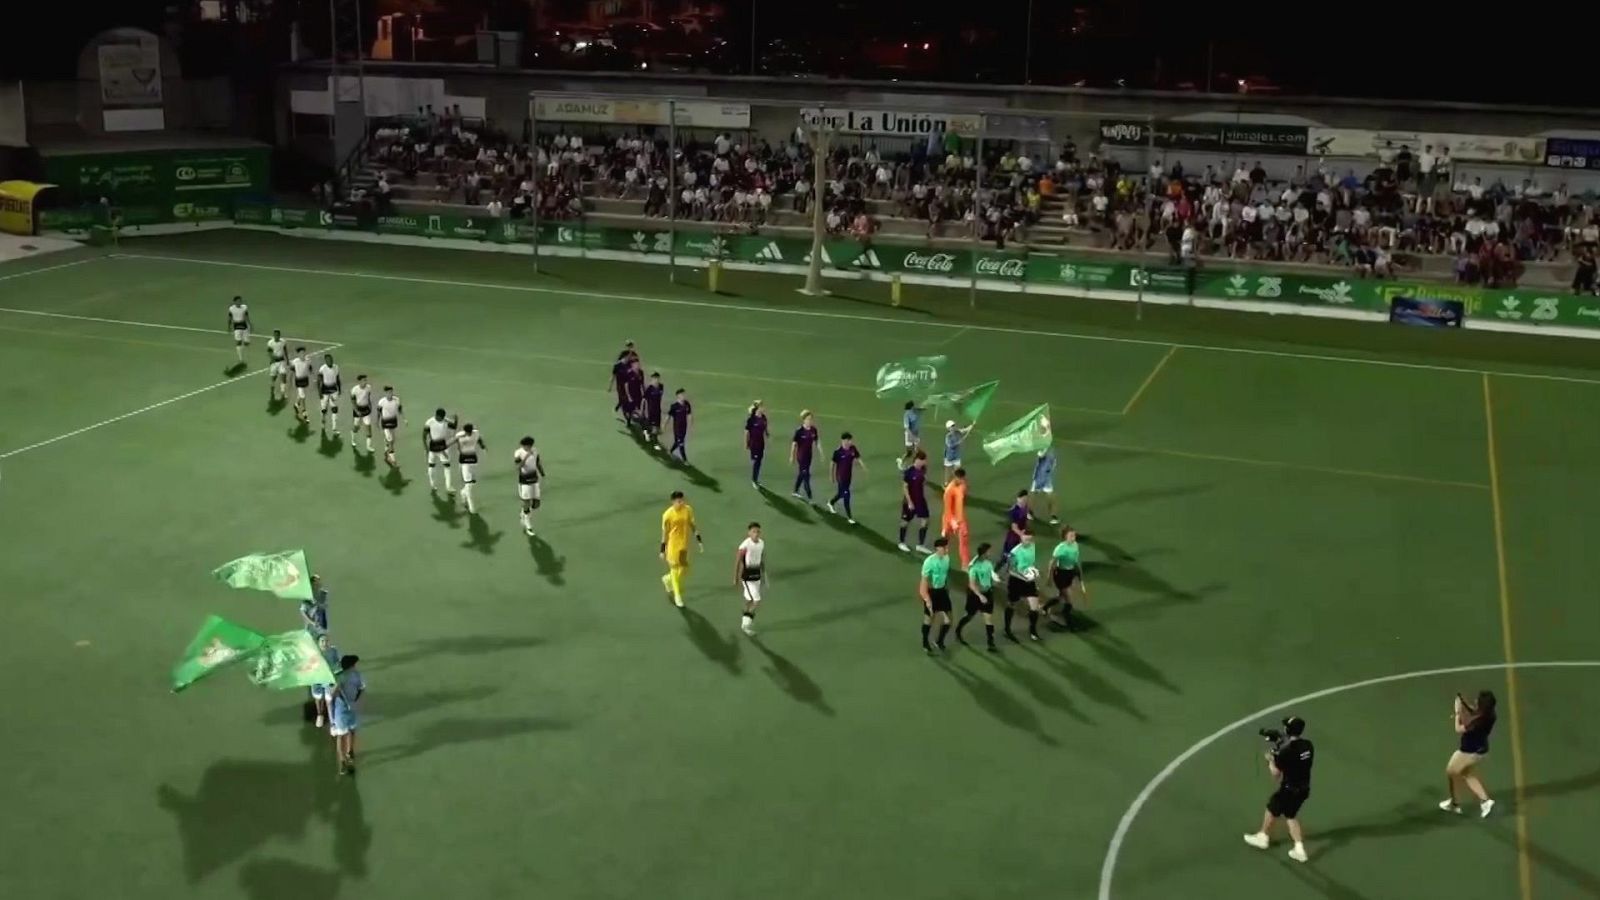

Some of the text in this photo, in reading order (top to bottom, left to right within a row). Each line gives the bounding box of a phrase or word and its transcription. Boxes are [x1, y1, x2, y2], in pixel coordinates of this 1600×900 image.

[556, 103, 609, 116] ADAMUZ
[847, 111, 873, 132] La
[882, 113, 946, 134] Unión
[1256, 276, 1282, 298] 25
[1530, 297, 1559, 320] 25
